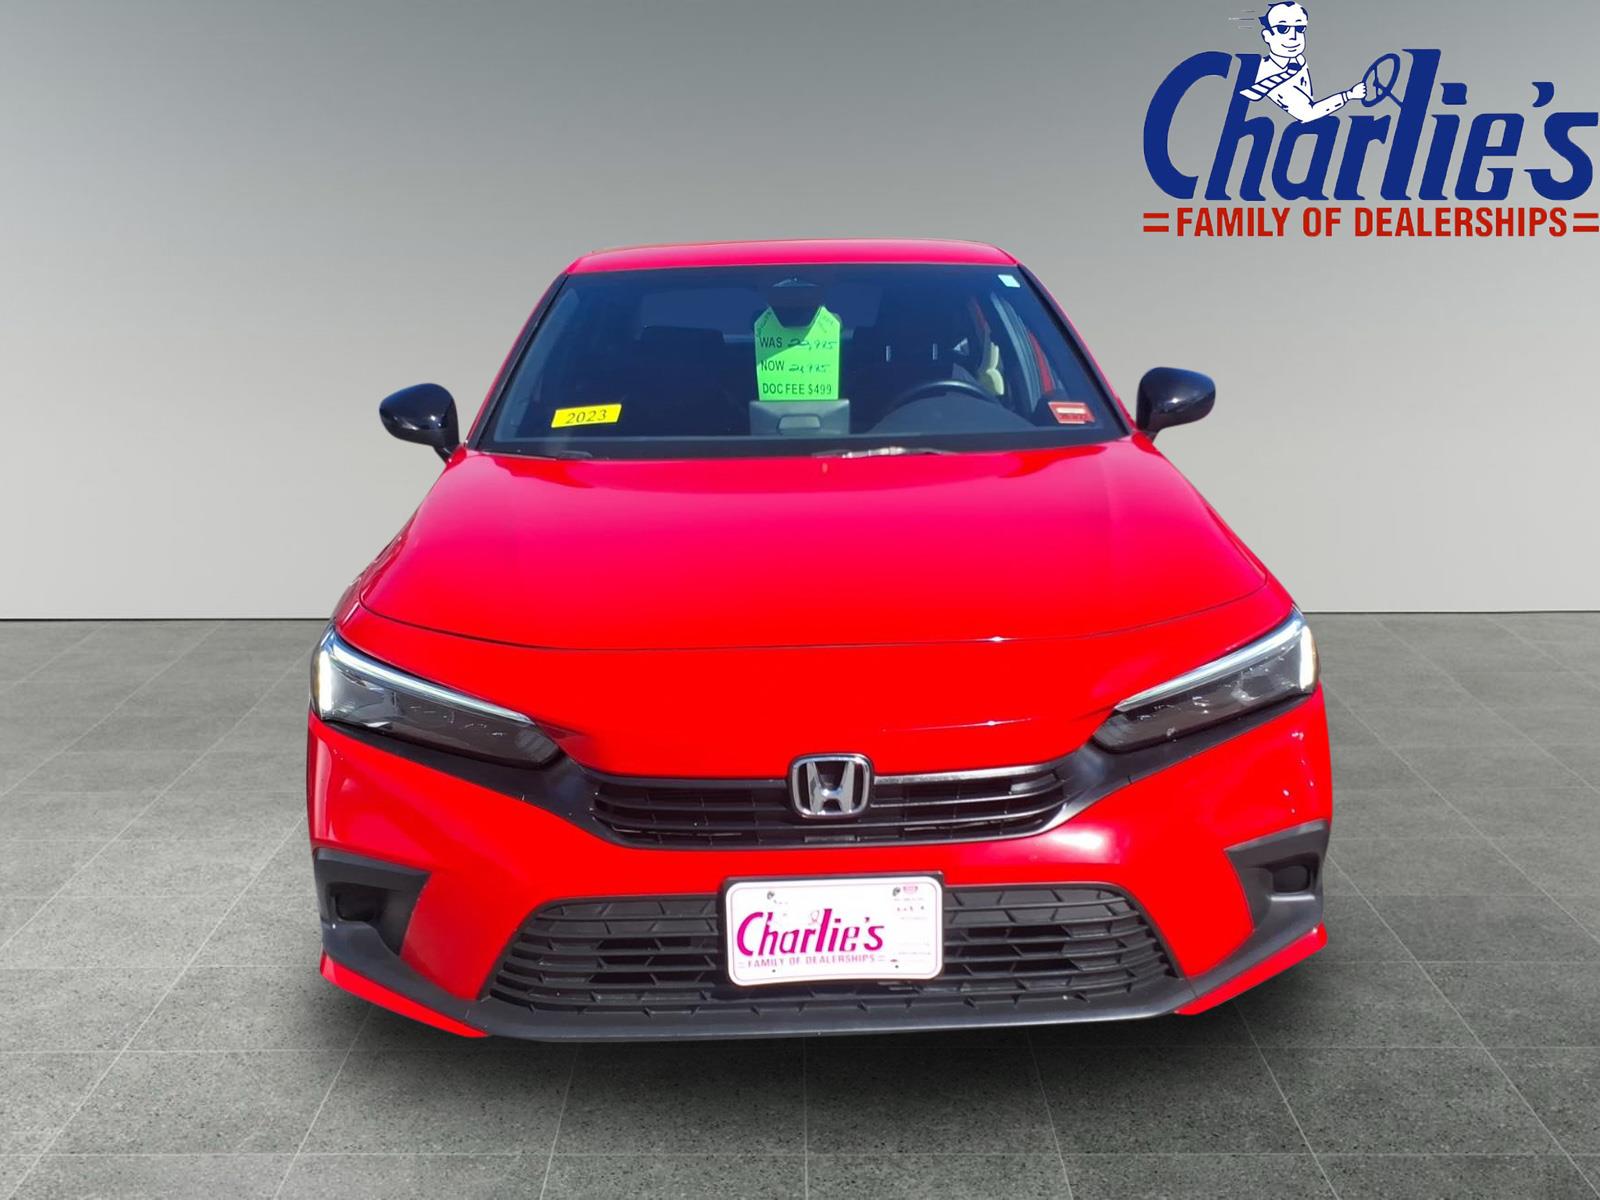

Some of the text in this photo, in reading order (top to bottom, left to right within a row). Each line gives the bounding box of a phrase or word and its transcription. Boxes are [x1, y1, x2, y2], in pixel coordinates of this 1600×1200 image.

[759, 337, 783, 348] WAS
[760, 360, 785, 371] NOW
[762, 383, 832, 395] DOC FEE $499
[565, 409, 607, 424] 2023
[736, 908, 885, 957] Charlie's
[747, 953, 876, 969] FAMILY OF DEALERSHIPS
